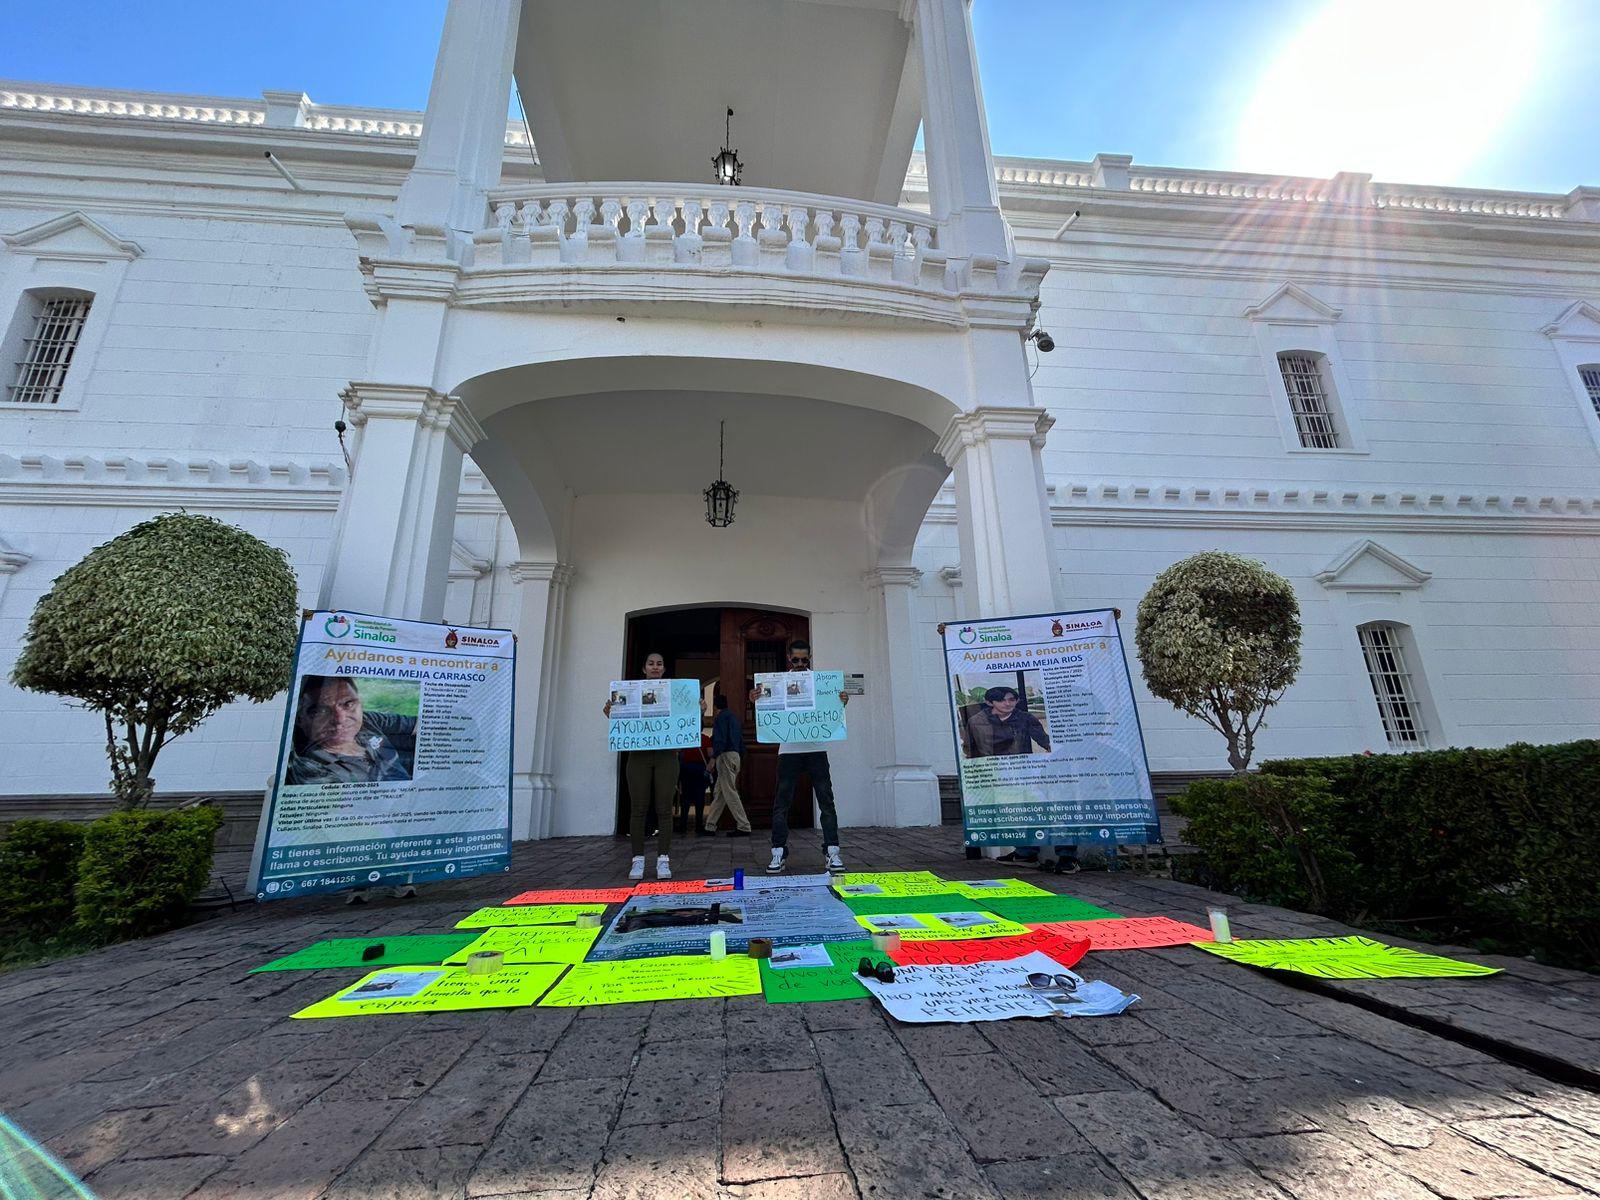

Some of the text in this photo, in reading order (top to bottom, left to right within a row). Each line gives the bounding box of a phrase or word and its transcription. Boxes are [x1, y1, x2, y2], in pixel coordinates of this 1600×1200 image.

[1065, 620, 1102, 629] SINALOA
[354, 629, 396, 642] Sinaloa
[461, 636, 499, 644] SINALOA
[980, 634, 1012, 643] Sinaloa
[325, 648, 499, 670] Ayúdanos a encontrar a
[964, 650, 1021, 663] Ayúdanos
[1036, 642, 1095, 655] encontrar
[1099, 642, 1106, 650] a
[986, 654, 1082, 670] ABRAHAM MEJIA RIOS
[336, 666, 486, 682] ABRAHAM MEJIA CARRASCO
[610, 717, 696, 734] AYUDALOS QUE
[758, 712, 781, 727] LOS
[772, 724, 832, 743] VIVOS
[610, 733, 700, 750] REGRESEN A CASA
[999, 805, 1043, 813] información
[1115, 802, 1151, 811] persona,
[994, 815, 1035, 823] escribenos.
[1048, 814, 1072, 823] ayuda
[1105, 812, 1152, 821] importante.
[272, 850, 282, 859] Si
[288, 848, 321, 858] tienes
[326, 842, 386, 854] información
[390, 839, 432, 849] referente
[467, 834, 504, 844] persona,
[270, 862, 300, 870] llama
[313, 855, 373, 866] escribenos.
[376, 852, 388, 860] Tu
[390, 849, 419, 860] ayuda
[421, 848, 432, 856] es
[434, 847, 453, 856] muy
[455, 842, 504, 853] importante.
[301, 876, 356, 888] 667 1841256
[900, 942, 940, 954] NO
[957, 933, 1055, 952] ESTAMOS
[926, 966, 957, 974] VEZ
[895, 975, 922, 985] LAS
[930, 973, 963, 982] QUE
[479, 989, 503, 997] que
[917, 989, 969, 999] VAMOS
[979, 986, 992, 994] A
[925, 998, 958, 1008] UNA
[963, 996, 992, 1005] VIDA
